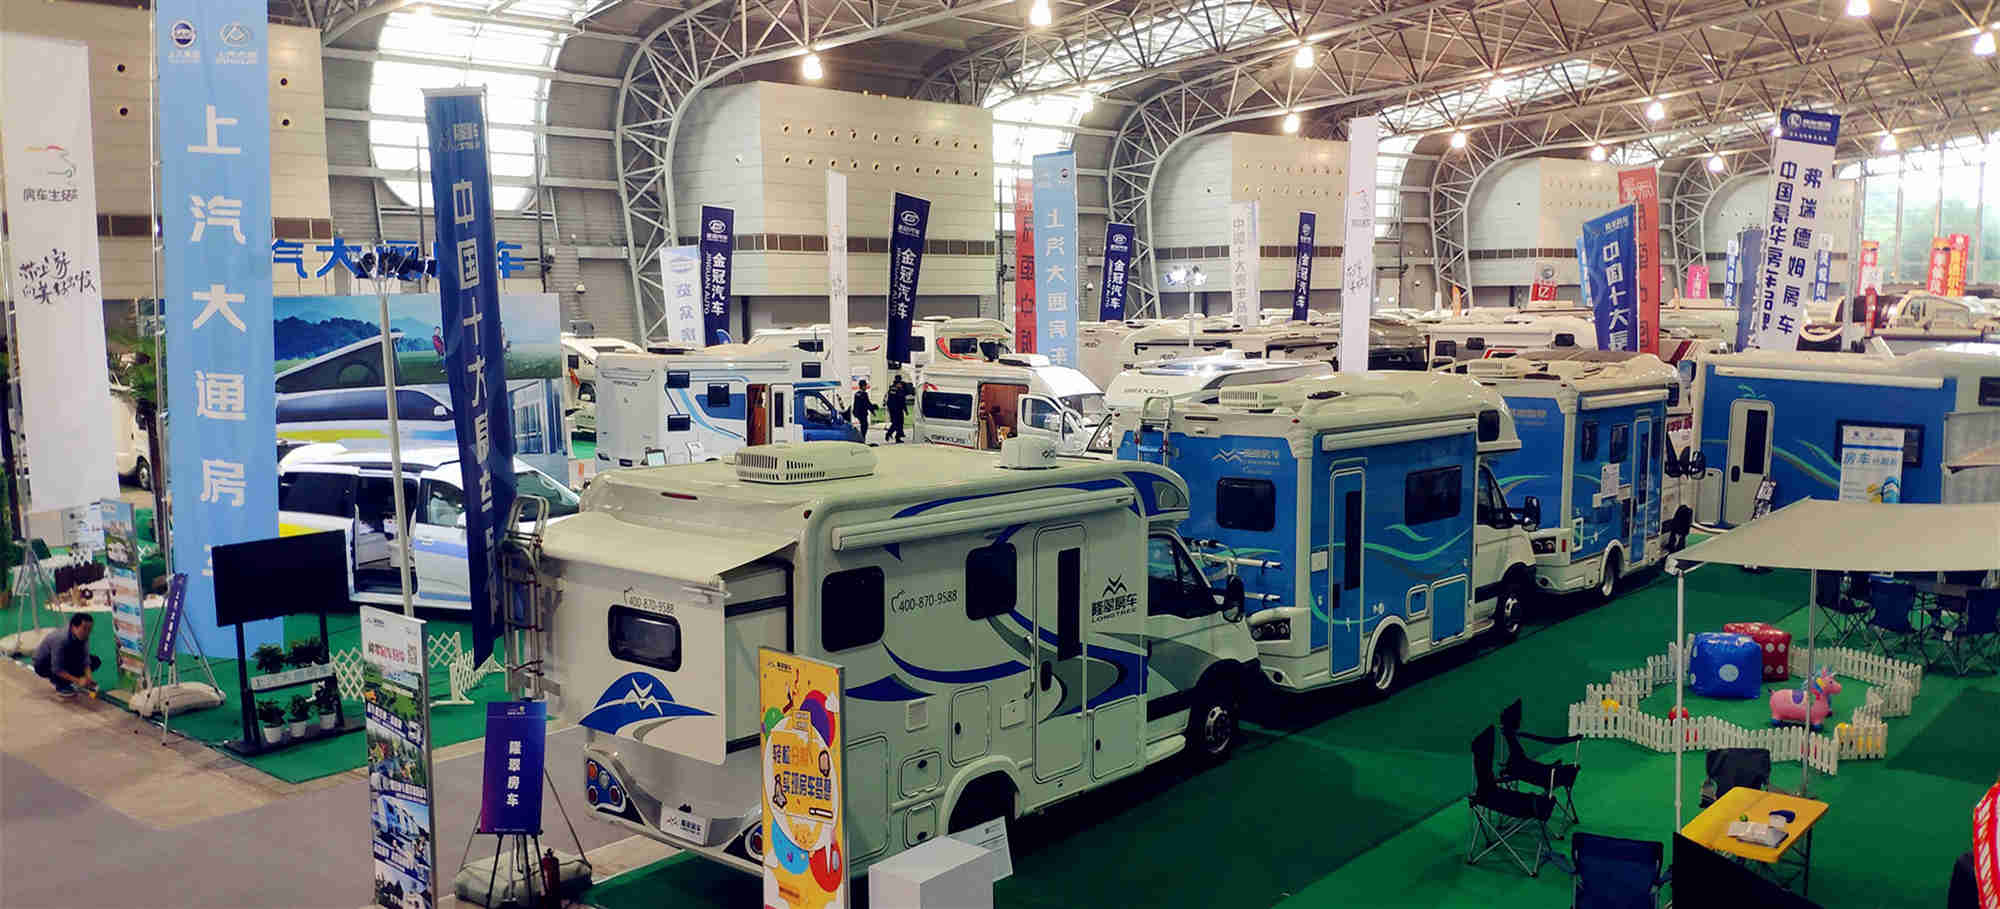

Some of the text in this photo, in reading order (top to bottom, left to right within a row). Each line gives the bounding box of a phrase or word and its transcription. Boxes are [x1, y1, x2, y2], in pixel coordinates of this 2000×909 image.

[703, 252, 712, 315] JINGUAN AUTO
[711, 252, 728, 316] 金冠汽车
[898, 248, 917, 319] 金冠汽车
[1761, 161, 1798, 331] 中国豪华房车品牌
[1778, 167, 1823, 335] 弗瑞德姆房车
[187, 104, 248, 576] 上汽大通房
